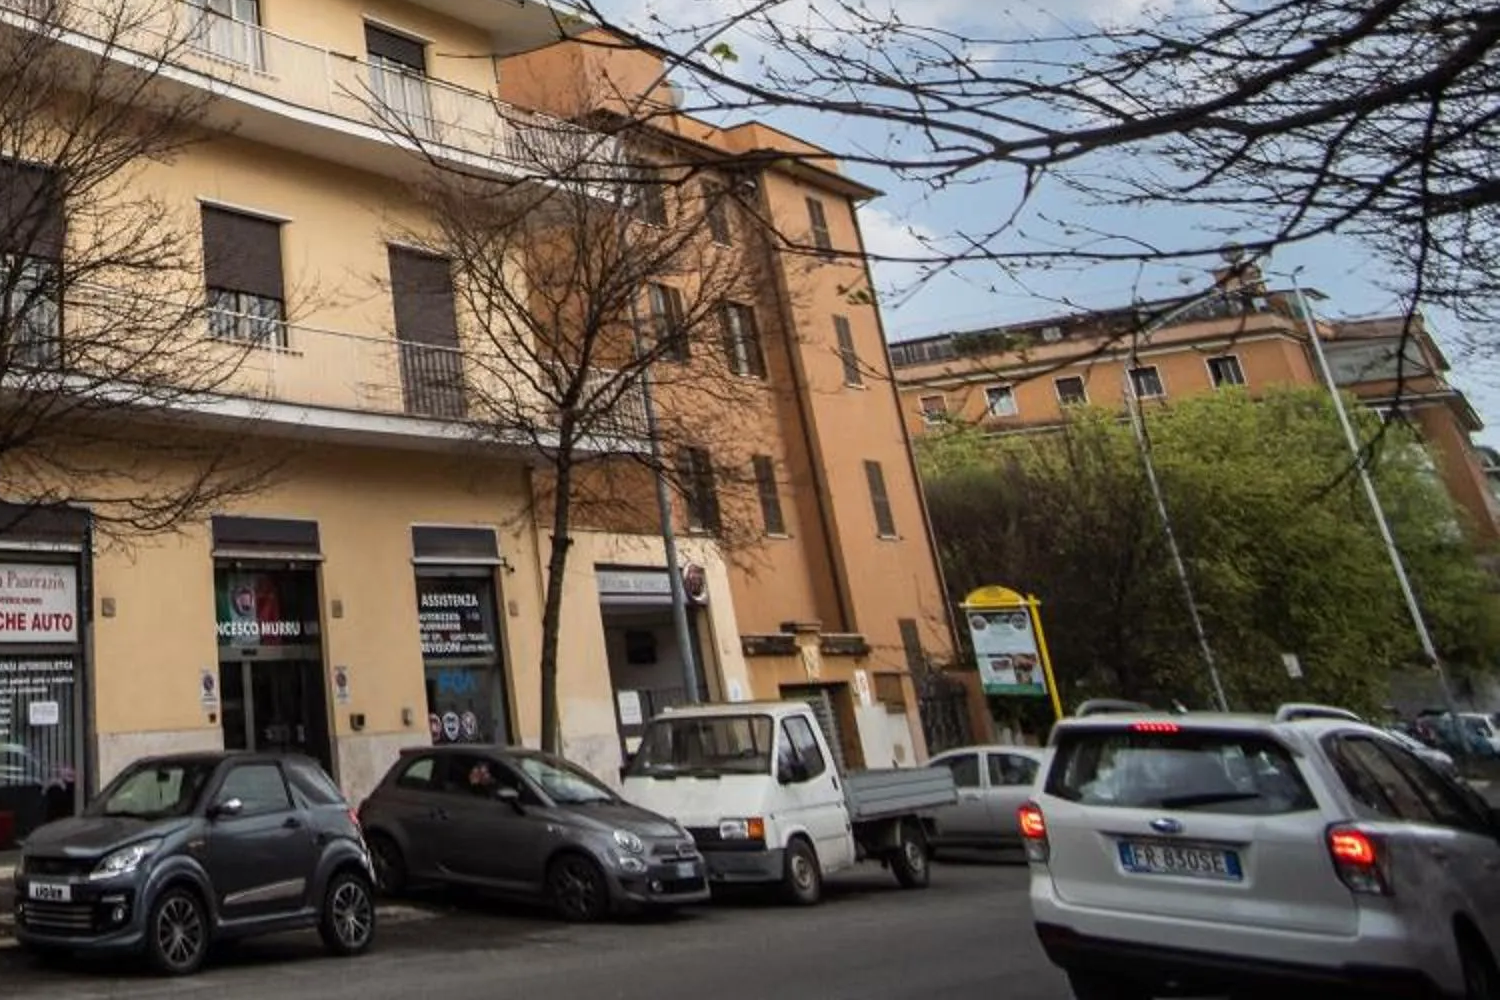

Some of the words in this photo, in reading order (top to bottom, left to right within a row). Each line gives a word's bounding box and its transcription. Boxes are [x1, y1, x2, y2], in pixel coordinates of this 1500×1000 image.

[421, 594, 479, 607] ASSISTENZA
[31, 612, 73, 632] AUTO
[261, 621, 301, 636] MURRU
